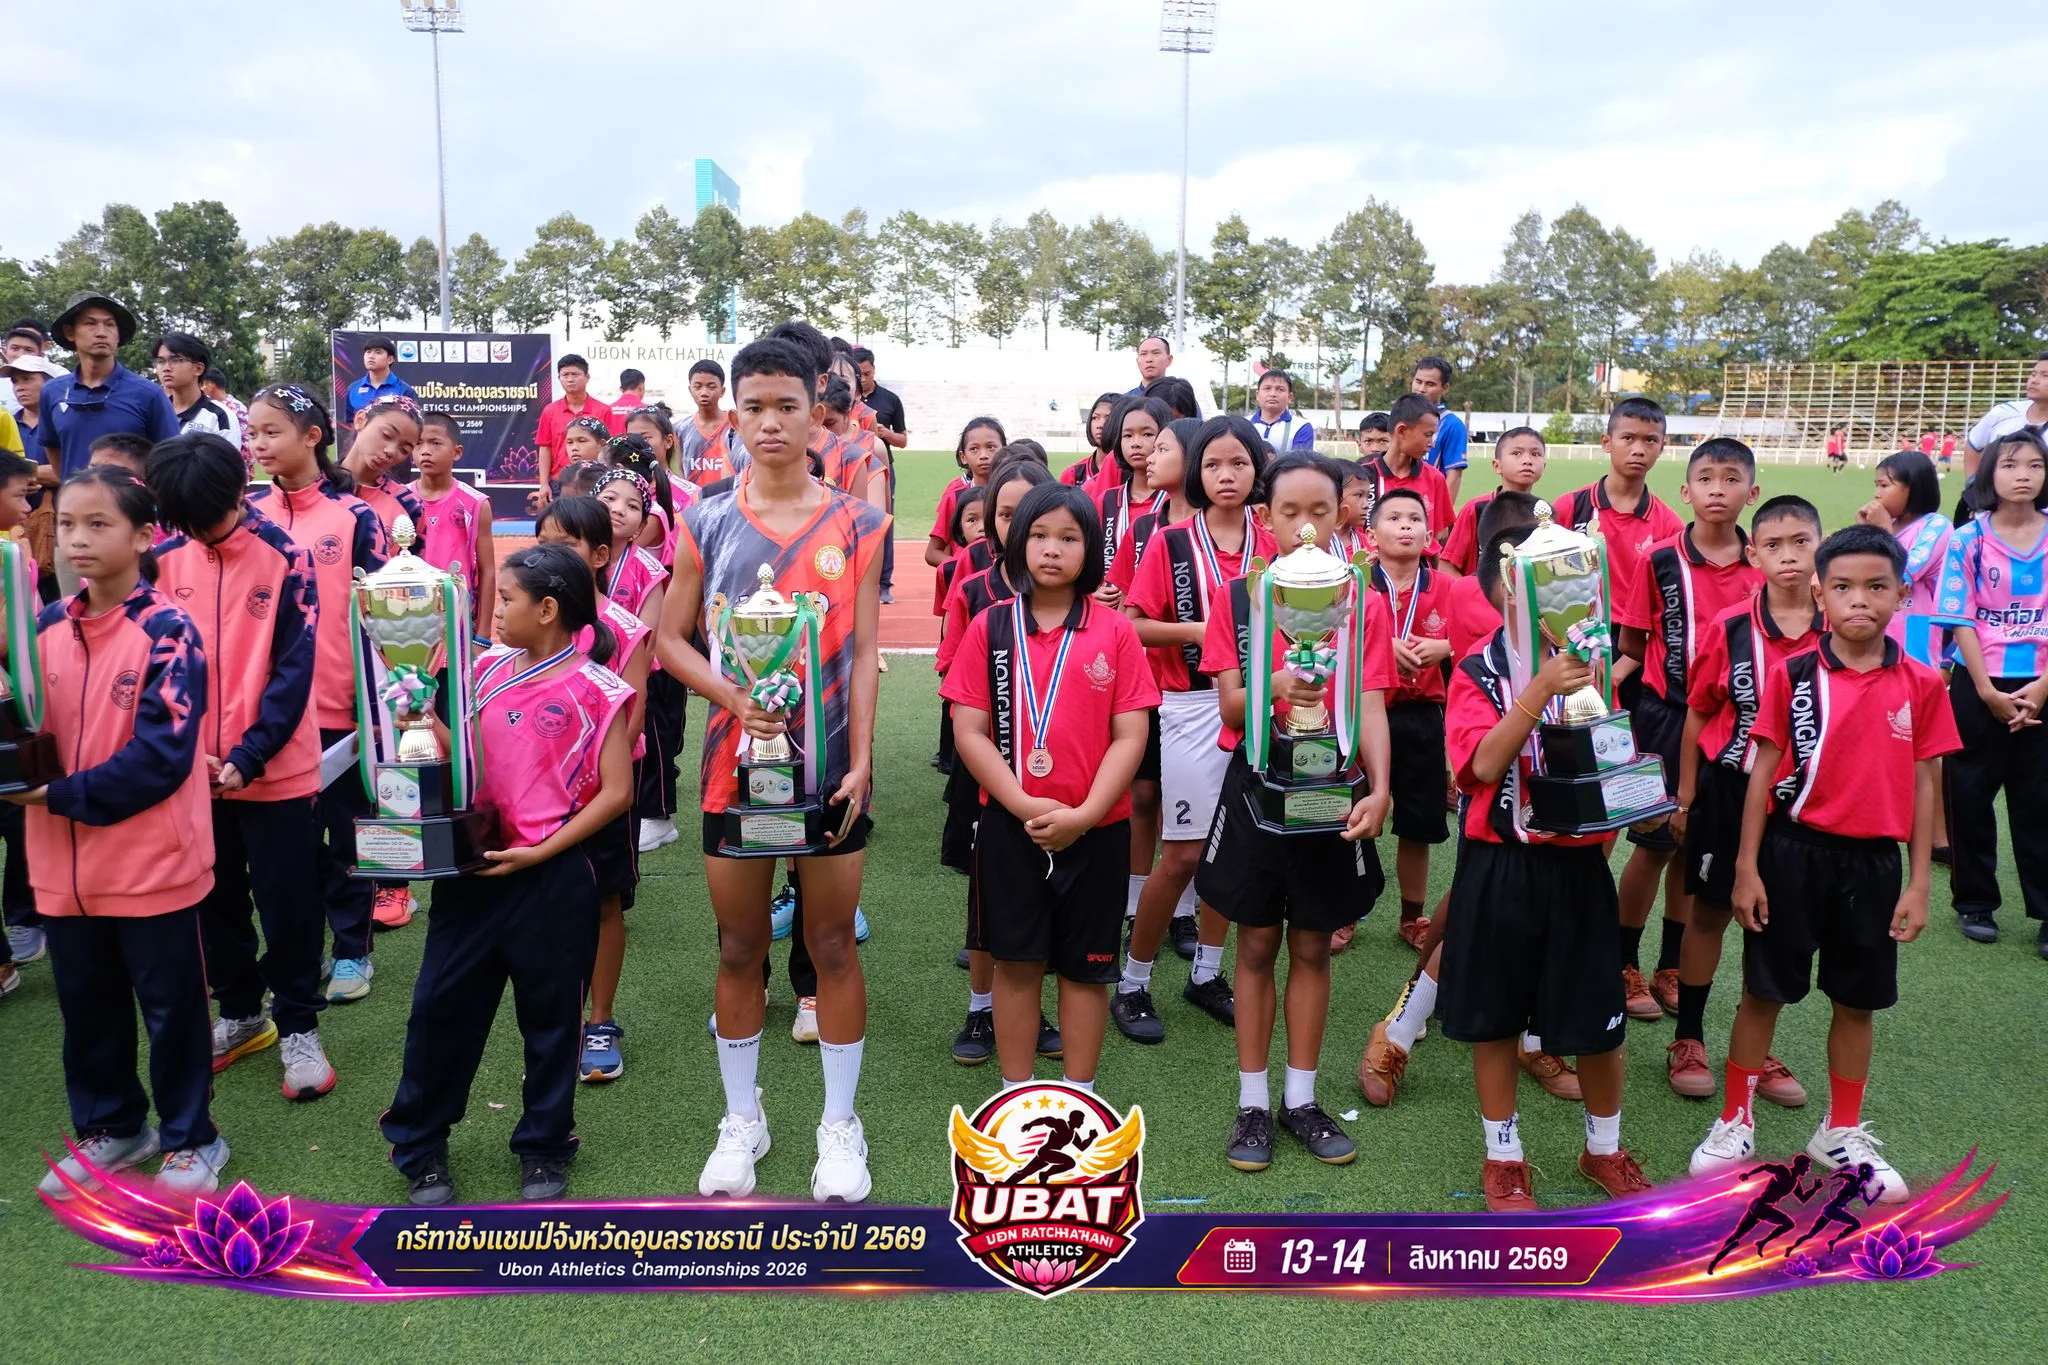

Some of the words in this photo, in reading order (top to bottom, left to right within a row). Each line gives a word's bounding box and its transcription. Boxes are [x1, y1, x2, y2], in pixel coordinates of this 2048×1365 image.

[587, 346, 630, 360] UBON
[637, 347, 725, 361] RATCHATHA
[421, 404, 450, 412] ETICS
[453, 404, 527, 412] CHAMPIONSHIPS
[466, 420, 483, 428] 2569
[1988, 566, 2000, 589] 9
[1175, 800, 1191, 825] 2
[1087, 954, 1114, 962] SPORT
